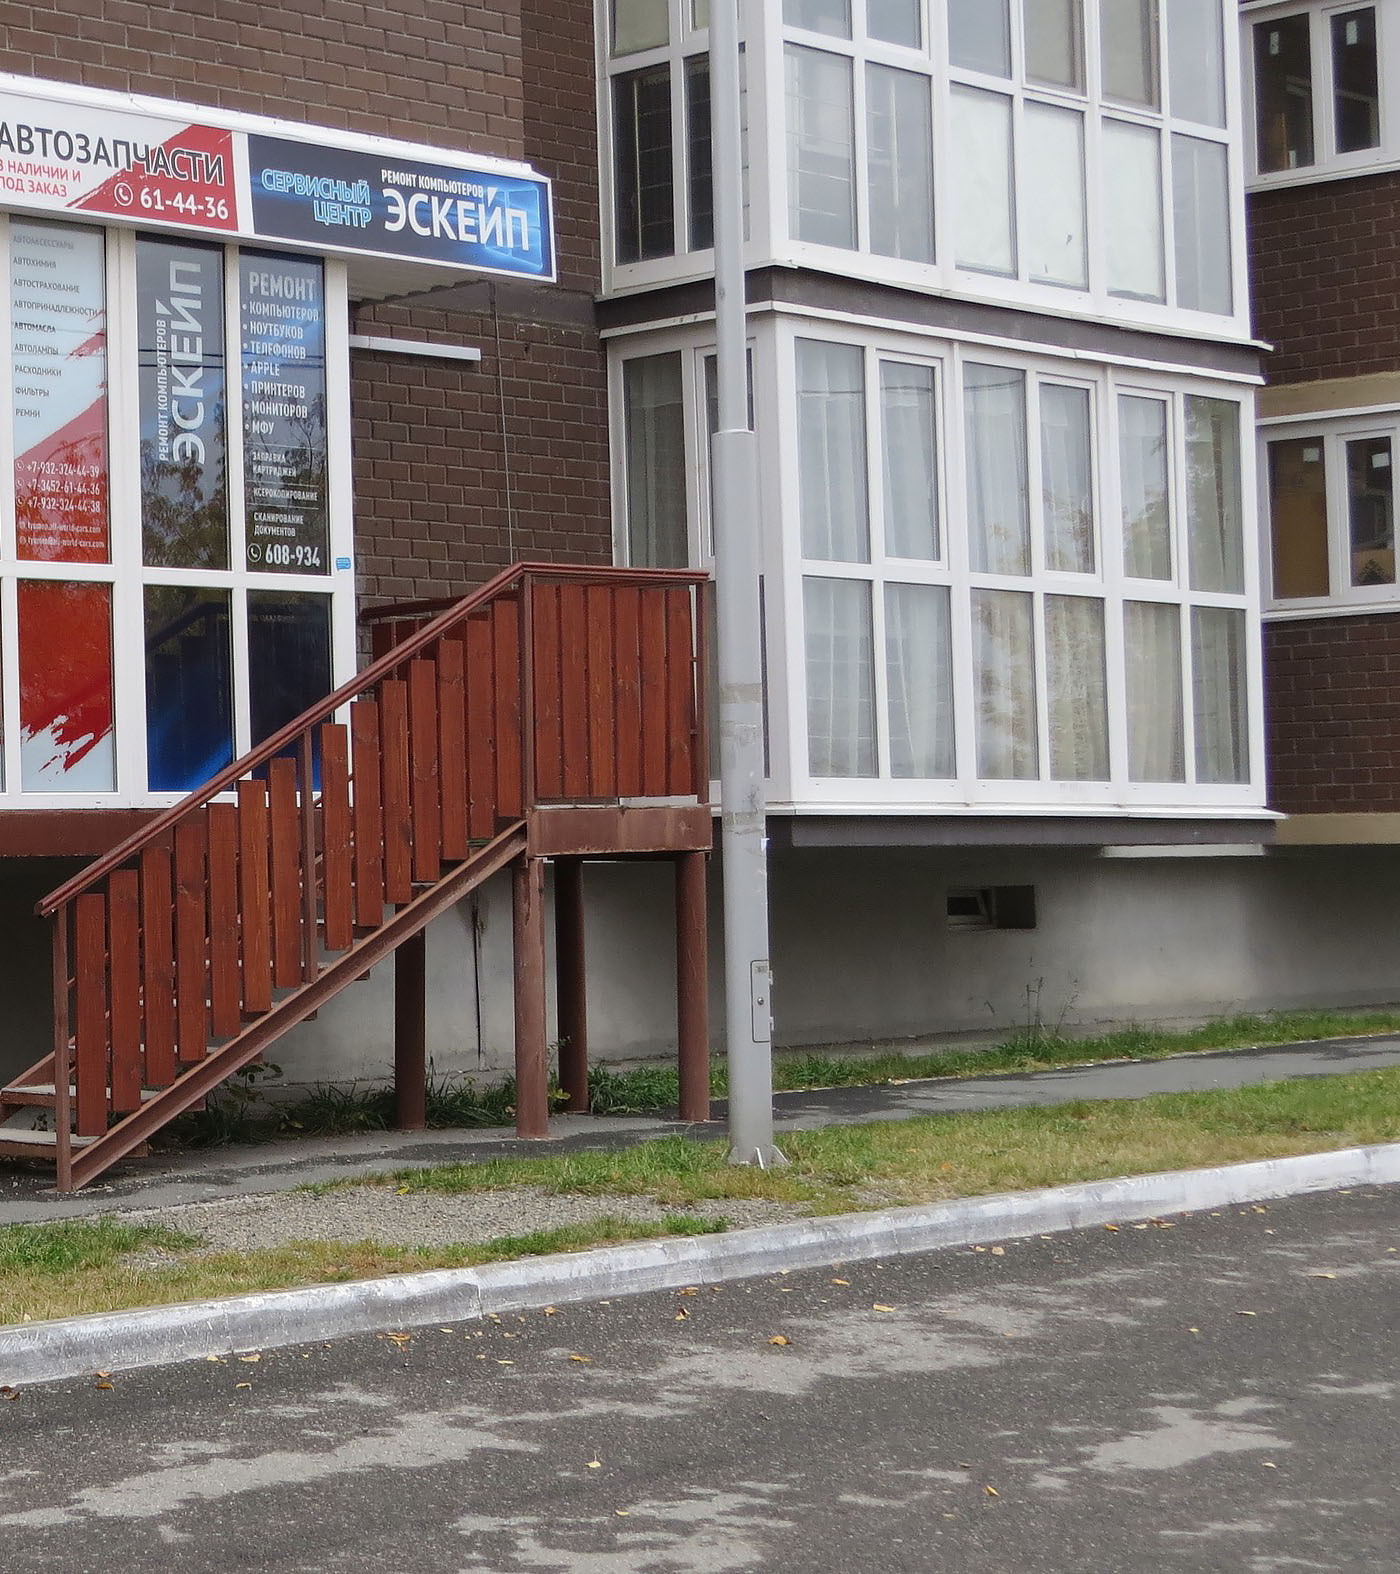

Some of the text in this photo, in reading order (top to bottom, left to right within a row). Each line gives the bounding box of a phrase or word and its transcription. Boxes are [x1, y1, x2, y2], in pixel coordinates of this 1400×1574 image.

[8, 160, 69, 181] НАЛИЧИИ
[72, 169, 81, 182] И
[28, 179, 67, 198] ЗАКАЗ
[261, 168, 371, 206] СЕРВИСНЫЙ
[381, 169, 484, 197] РЕМОНТ КОМПЬЮТЕРОВ
[140, 188, 228, 220] 61-44-36
[313, 199, 371, 229] ЦЕНТР
[382, 186, 530, 251] ЭСКЕЙП
[14, 278, 80, 293] АВТОСТРАХОВАНИЕ
[249, 271, 315, 301] РЕМОНТ
[250, 301, 319, 321] КОМПЬЮТЕРОВ
[14, 322, 56, 333] АВТОМАСЛА
[250, 321, 303, 339] НОУТБУКОВ
[14, 343, 59, 355] АВТОЛАМПЫ
[251, 341, 306, 360] ТЕЛЕФОНОВ
[14, 365, 61, 377] РАСХОДНИКИ
[156, 259, 205, 465] ЭСКЕЙП
[250, 361, 280, 377] APPLE
[15, 385, 49, 397] ФИЛЬТРЫ
[156, 319, 170, 462] РЕМОНТ КОМПЬЮТЕРОВ
[251, 381, 305, 399] ПРИНТЕРОВ
[15, 408, 40, 418] РЕМНИ
[252, 401, 308, 419] МОНИТОРОВ
[252, 421, 275, 435] МФУ
[254, 512, 304, 524] СКАНИРОВАНИЕ
[254, 525, 296, 537] ДОКУМЕНТОВ
[265, 543, 320, 567] 608-934
